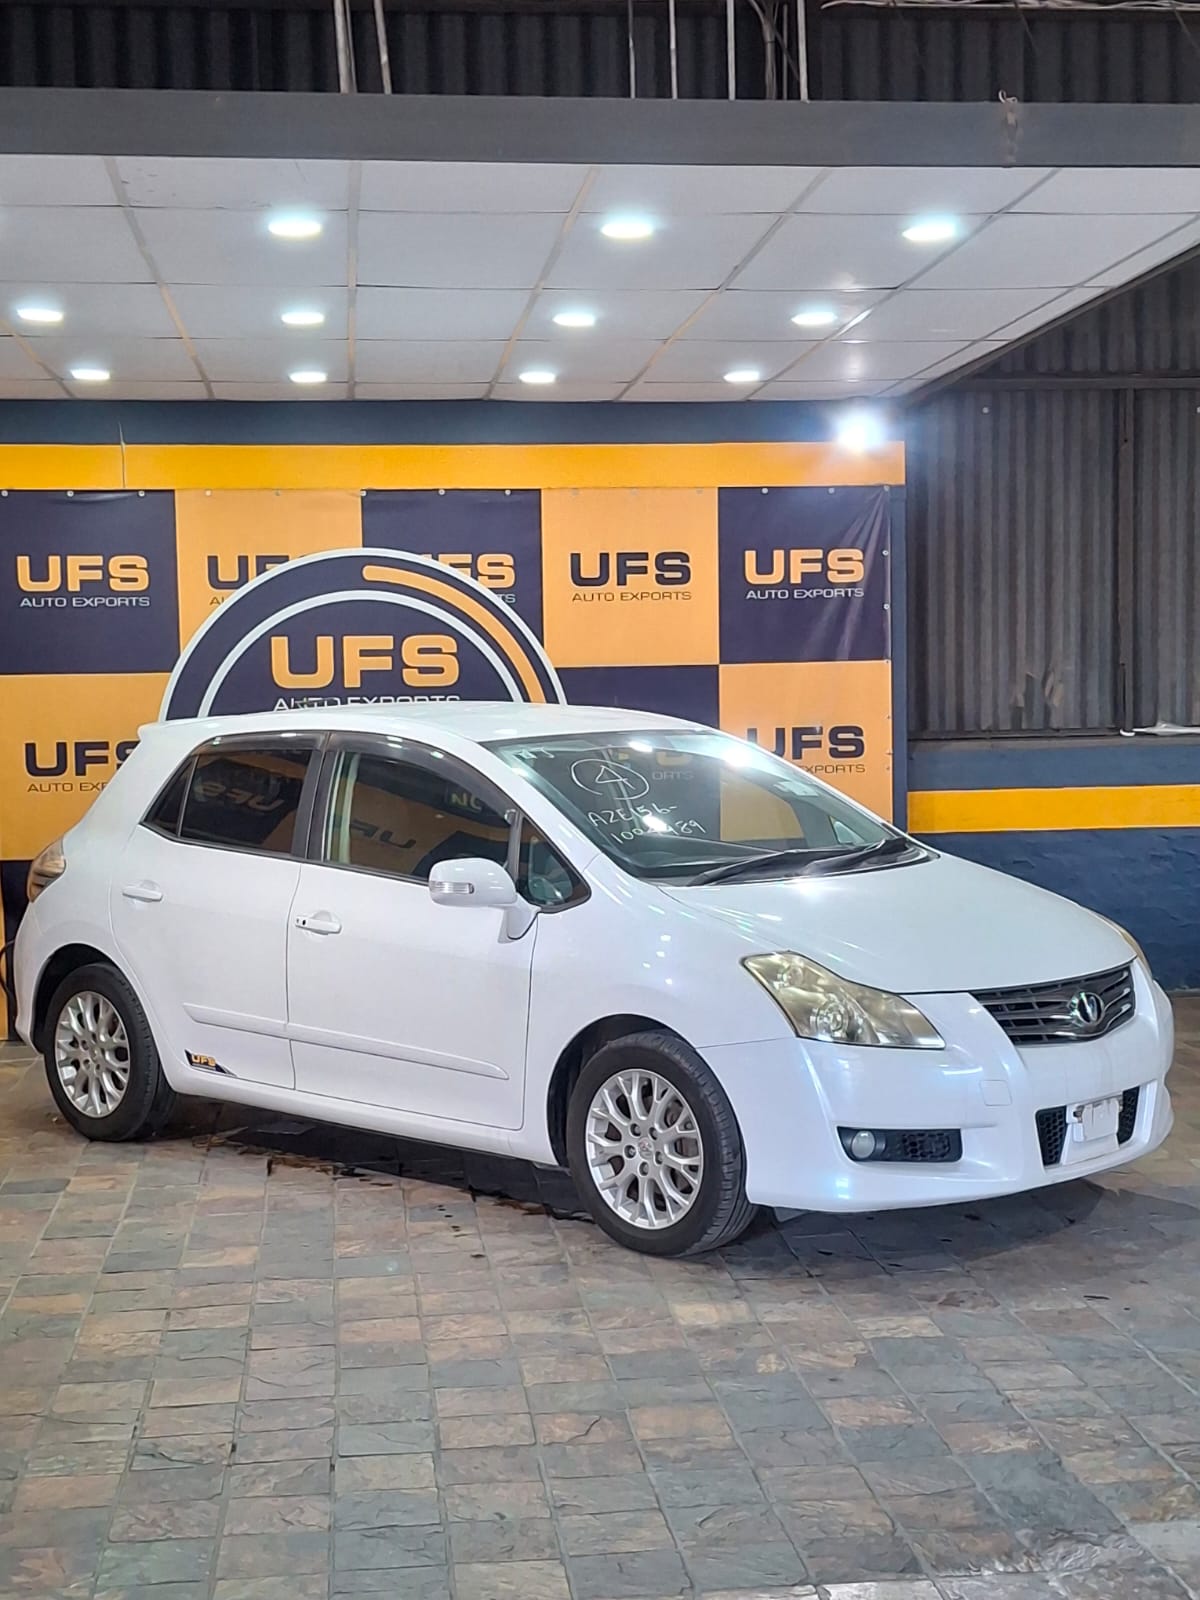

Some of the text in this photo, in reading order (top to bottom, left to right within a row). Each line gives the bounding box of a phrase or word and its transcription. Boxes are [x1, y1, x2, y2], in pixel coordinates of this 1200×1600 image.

[17, 555, 149, 592] UFS
[207, 555, 290, 590] UF
[421, 553, 515, 588] FS
[570, 551, 691, 587] UFS
[745, 549, 865, 585] UFS
[20, 597, 150, 607] AUTO EXPORTS
[572, 591, 692, 602] AUTO EXPORTS
[745, 588, 865, 600] AUTO EXPORTS
[271, 634, 460, 689] UFS
[27, 782, 73, 792] AUTO
